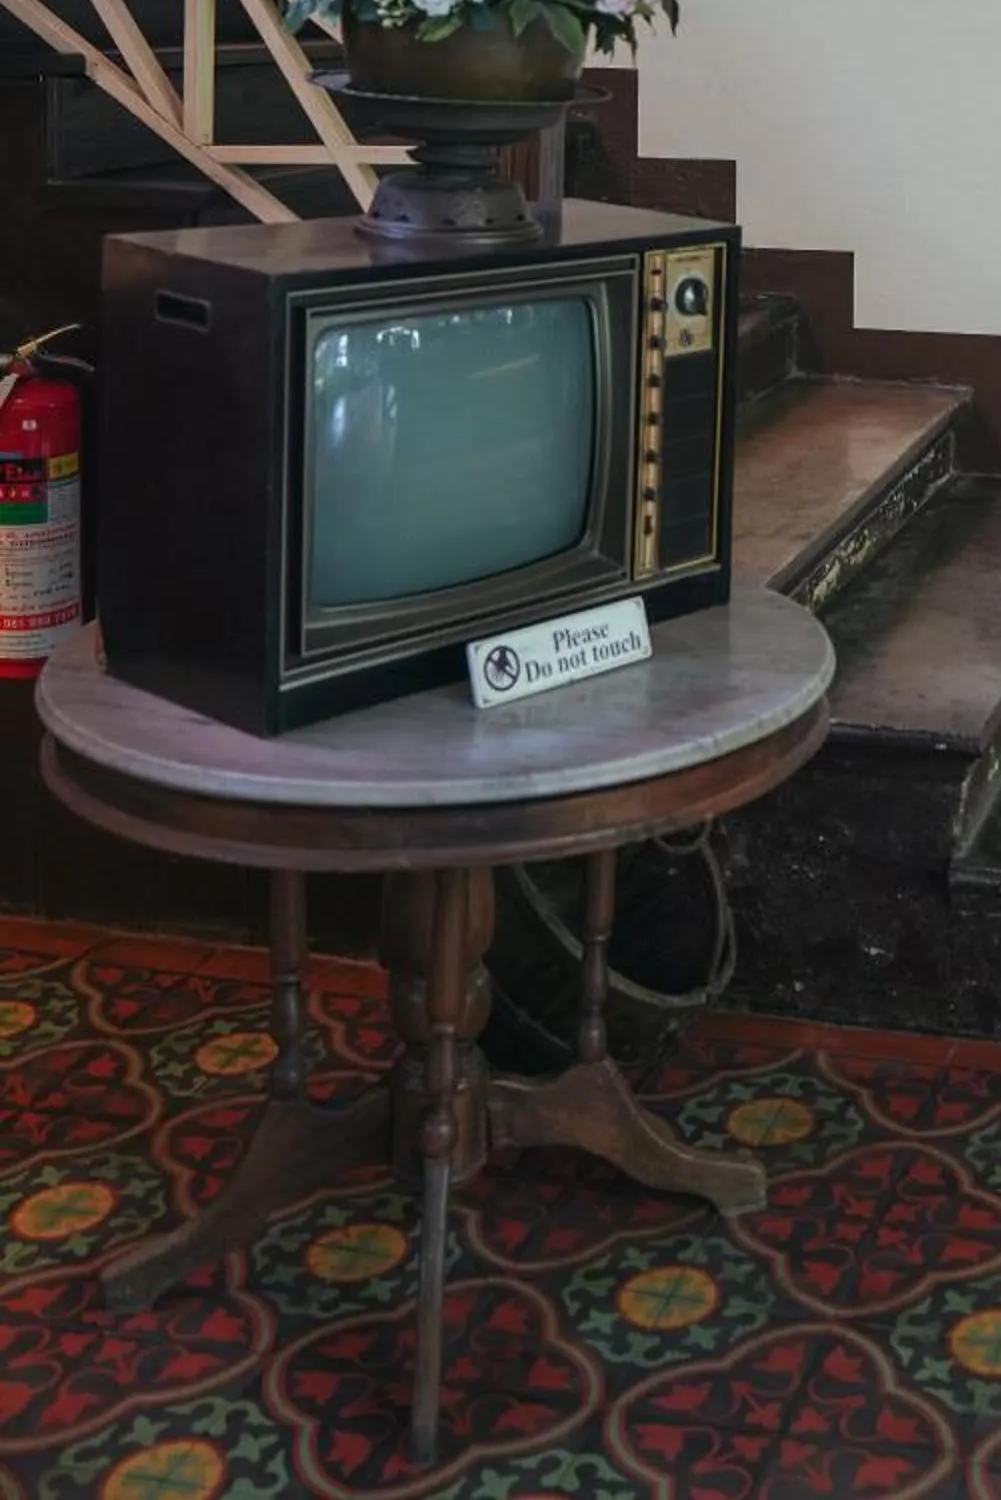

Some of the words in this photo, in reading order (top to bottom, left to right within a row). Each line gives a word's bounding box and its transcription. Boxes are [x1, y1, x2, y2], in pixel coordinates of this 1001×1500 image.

[524, 659, 553, 683] Do
[558, 650, 588, 673] not
[592, 631, 642, 661] touch
[552, 623, 610, 653] Please
